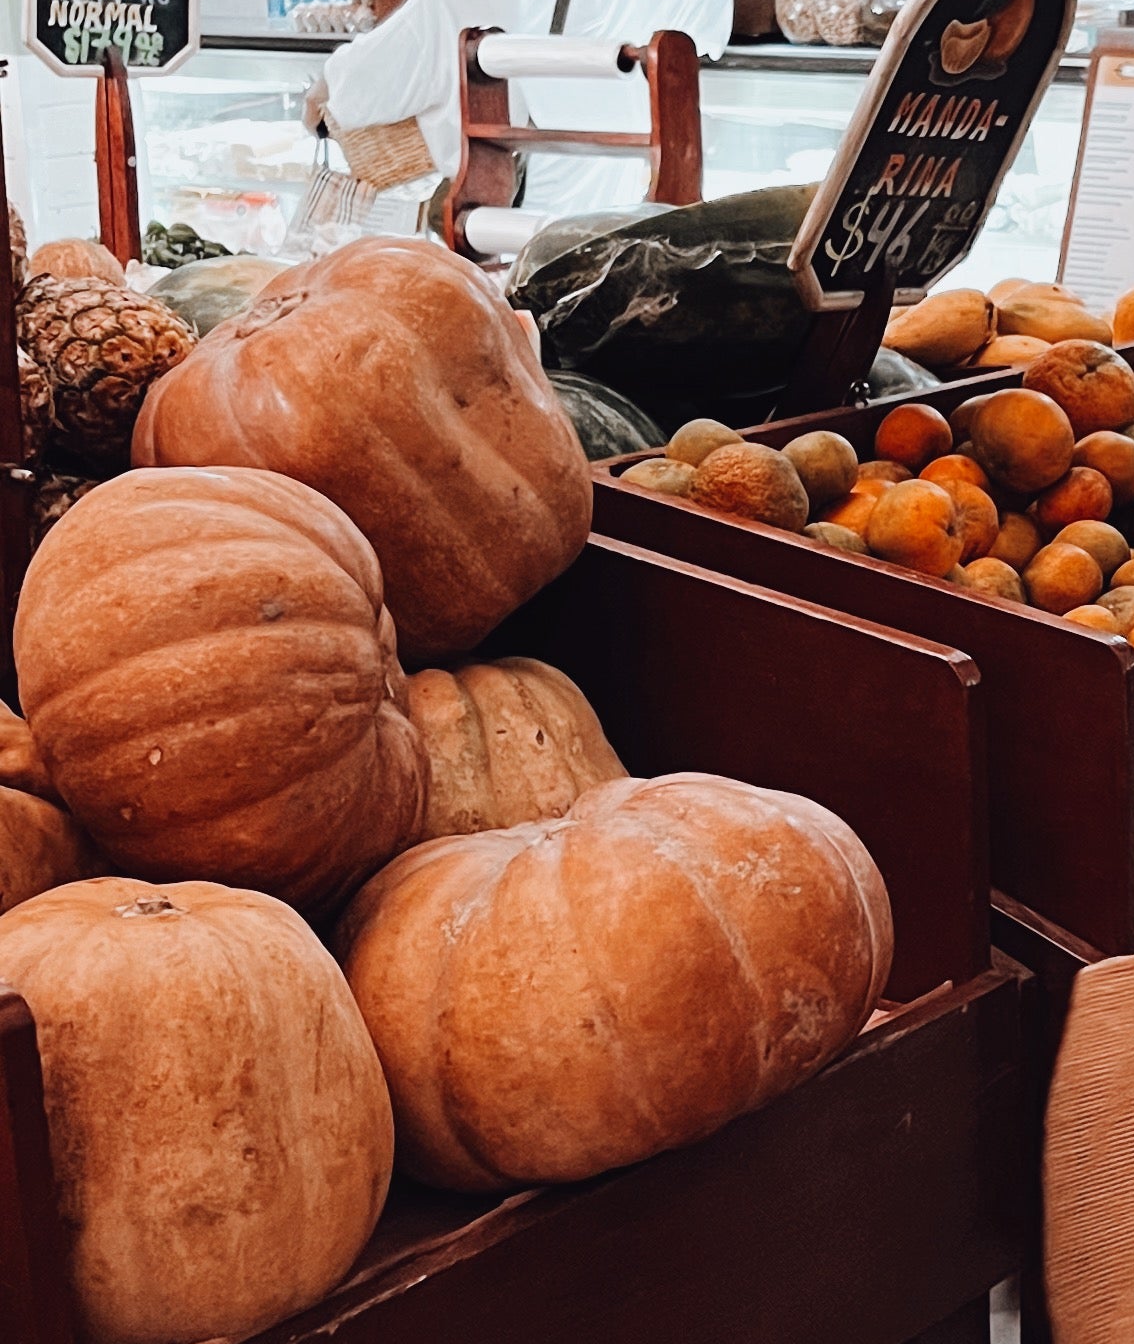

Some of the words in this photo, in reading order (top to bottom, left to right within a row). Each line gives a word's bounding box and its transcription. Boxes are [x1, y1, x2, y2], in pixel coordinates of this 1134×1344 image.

[48, 0, 158, 33] NORMAL
[887, 92, 1009, 142] MANDA-
[872, 154, 963, 198] RINA
